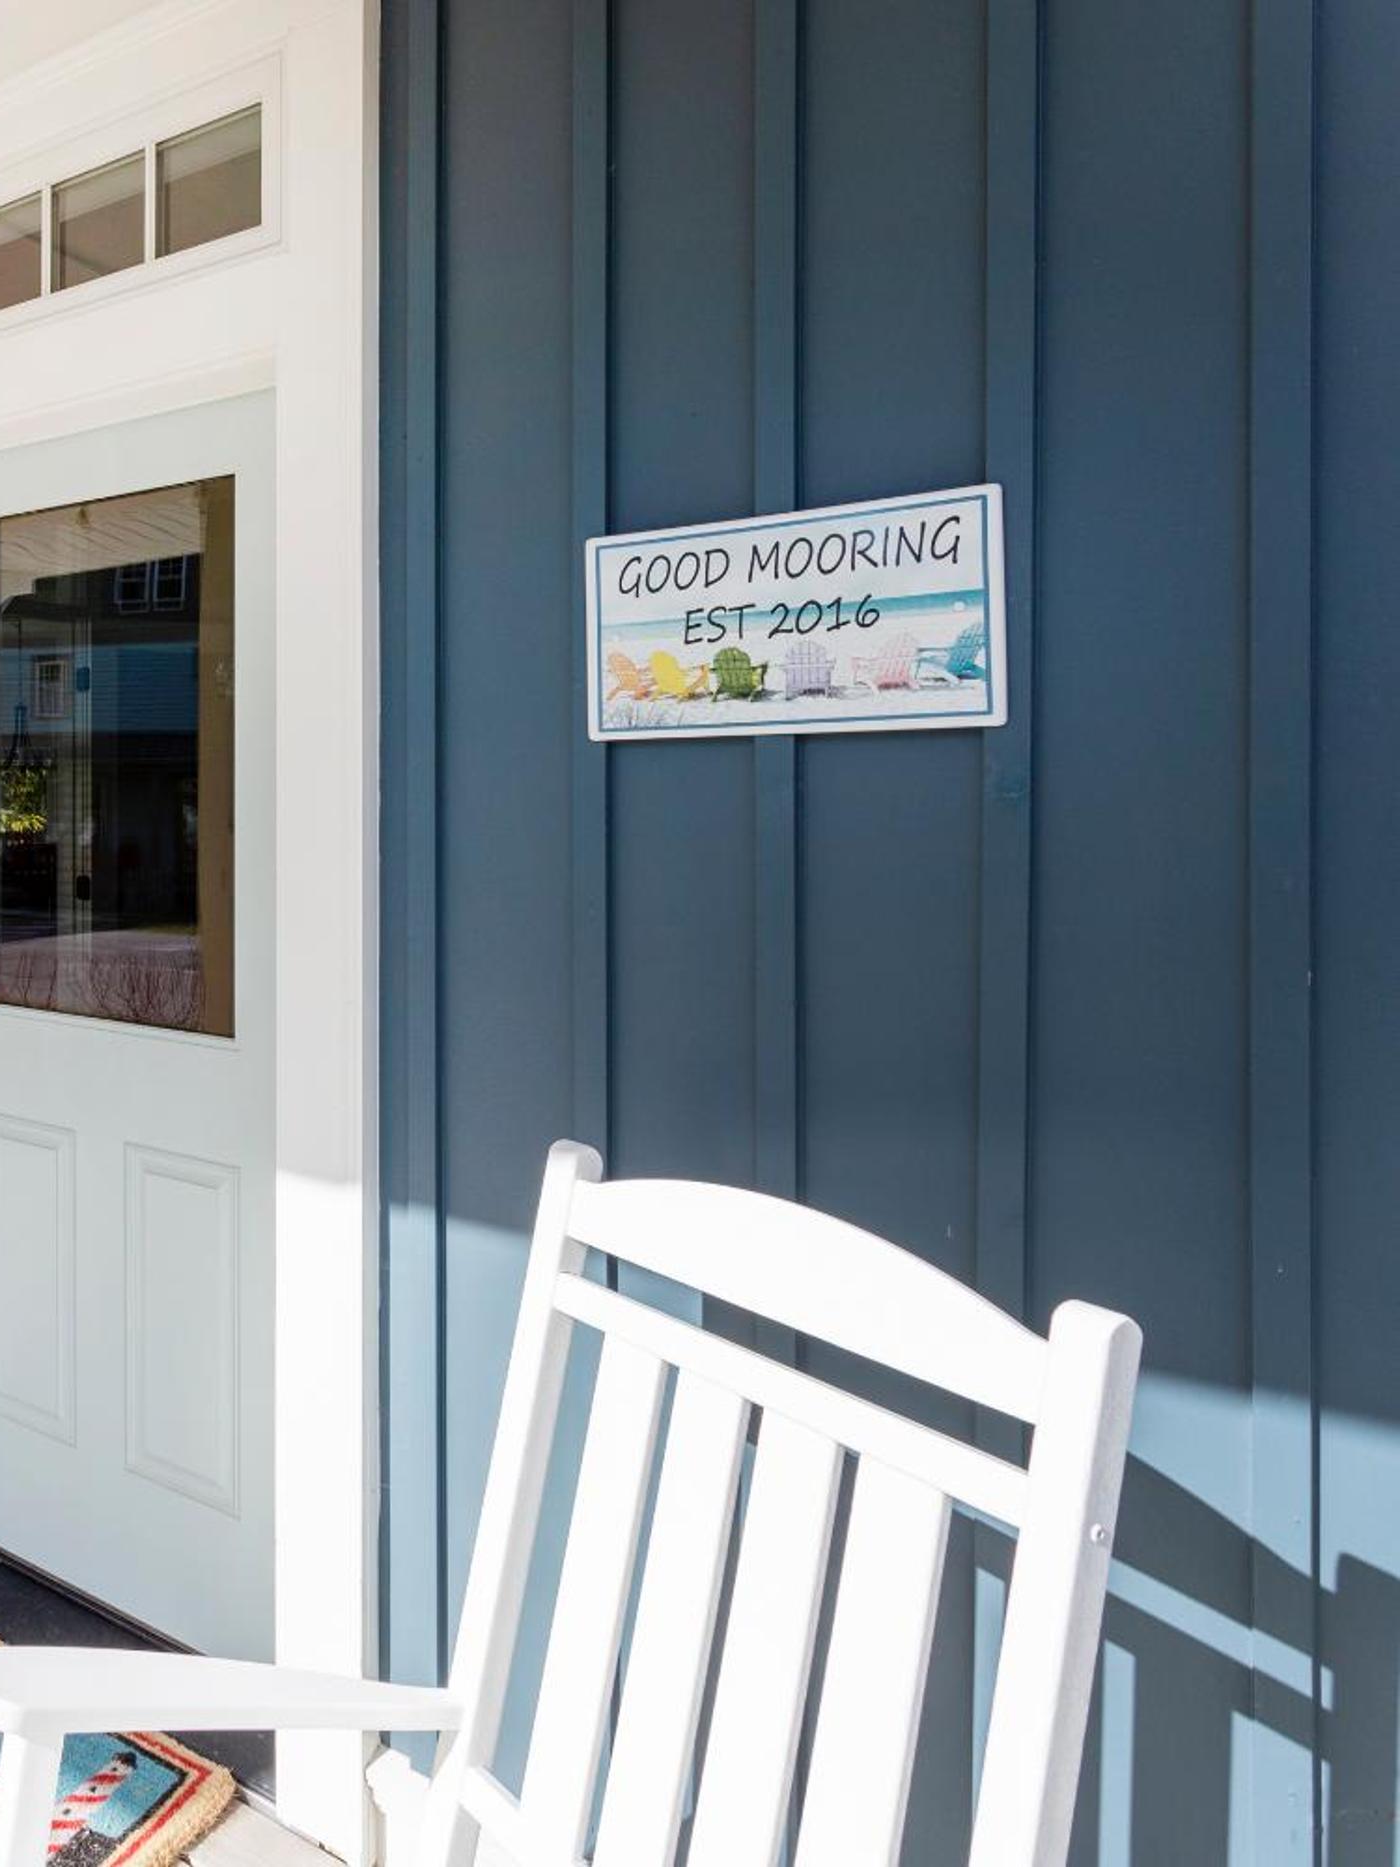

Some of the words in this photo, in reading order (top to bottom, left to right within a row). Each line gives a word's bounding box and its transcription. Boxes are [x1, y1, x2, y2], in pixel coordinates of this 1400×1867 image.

[618, 547, 730, 598] GOOD
[747, 515, 961, 583] MOORING
[683, 603, 756, 645] EST
[767, 593, 881, 639] 2016
